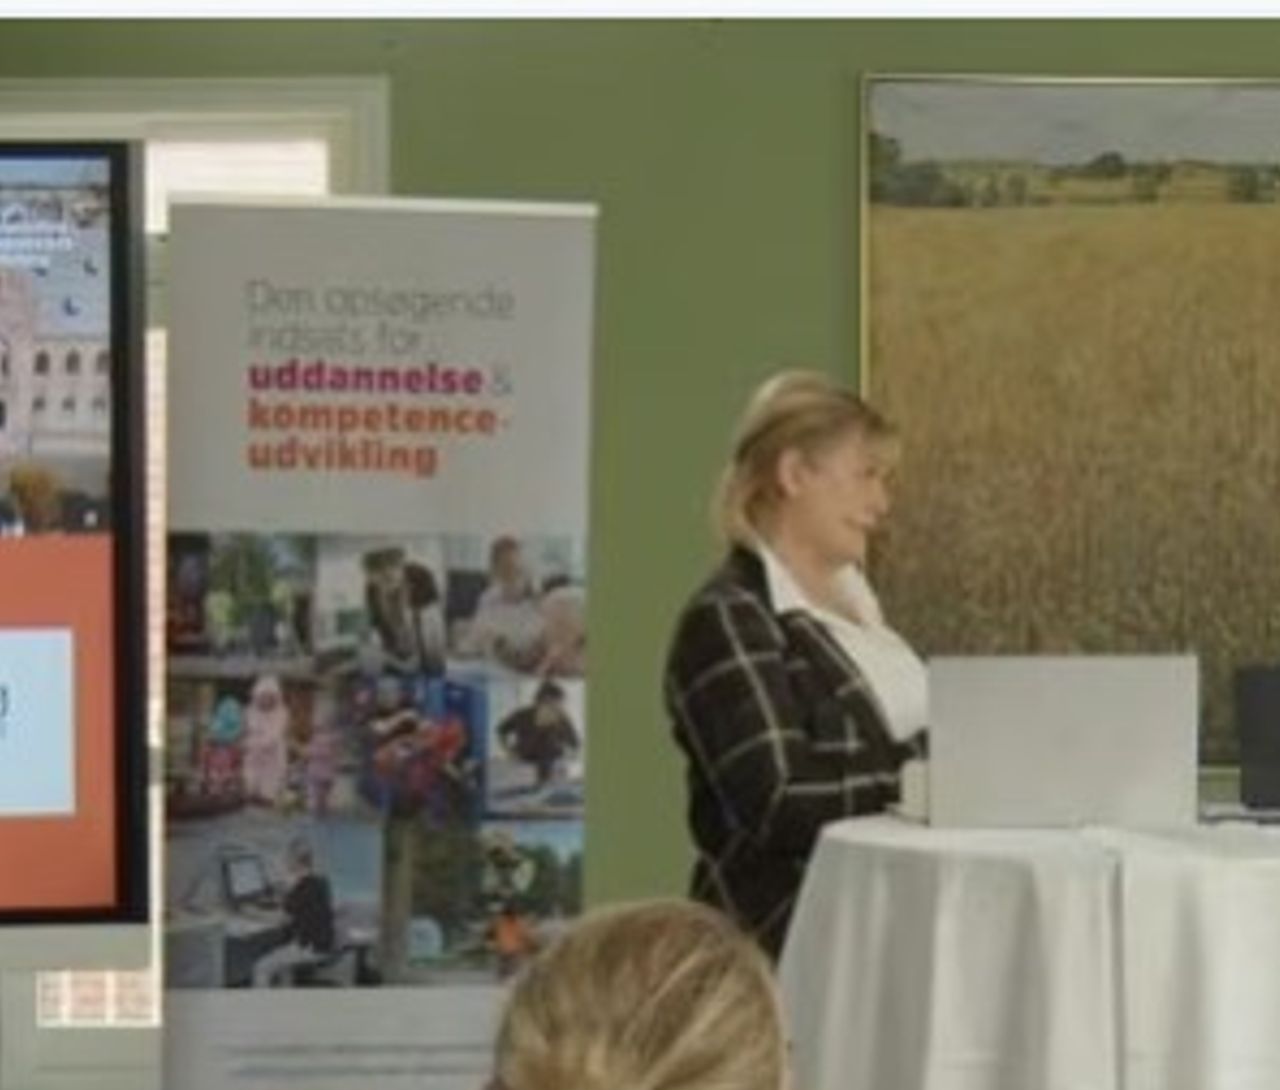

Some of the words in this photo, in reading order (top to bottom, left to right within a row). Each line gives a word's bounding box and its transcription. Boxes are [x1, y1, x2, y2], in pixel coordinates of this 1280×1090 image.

[245, 279, 315, 314] Den
[247, 359, 484, 394] uddannelse
[247, 398, 512, 434] kompetence-
[247, 437, 438, 478] udvikling
